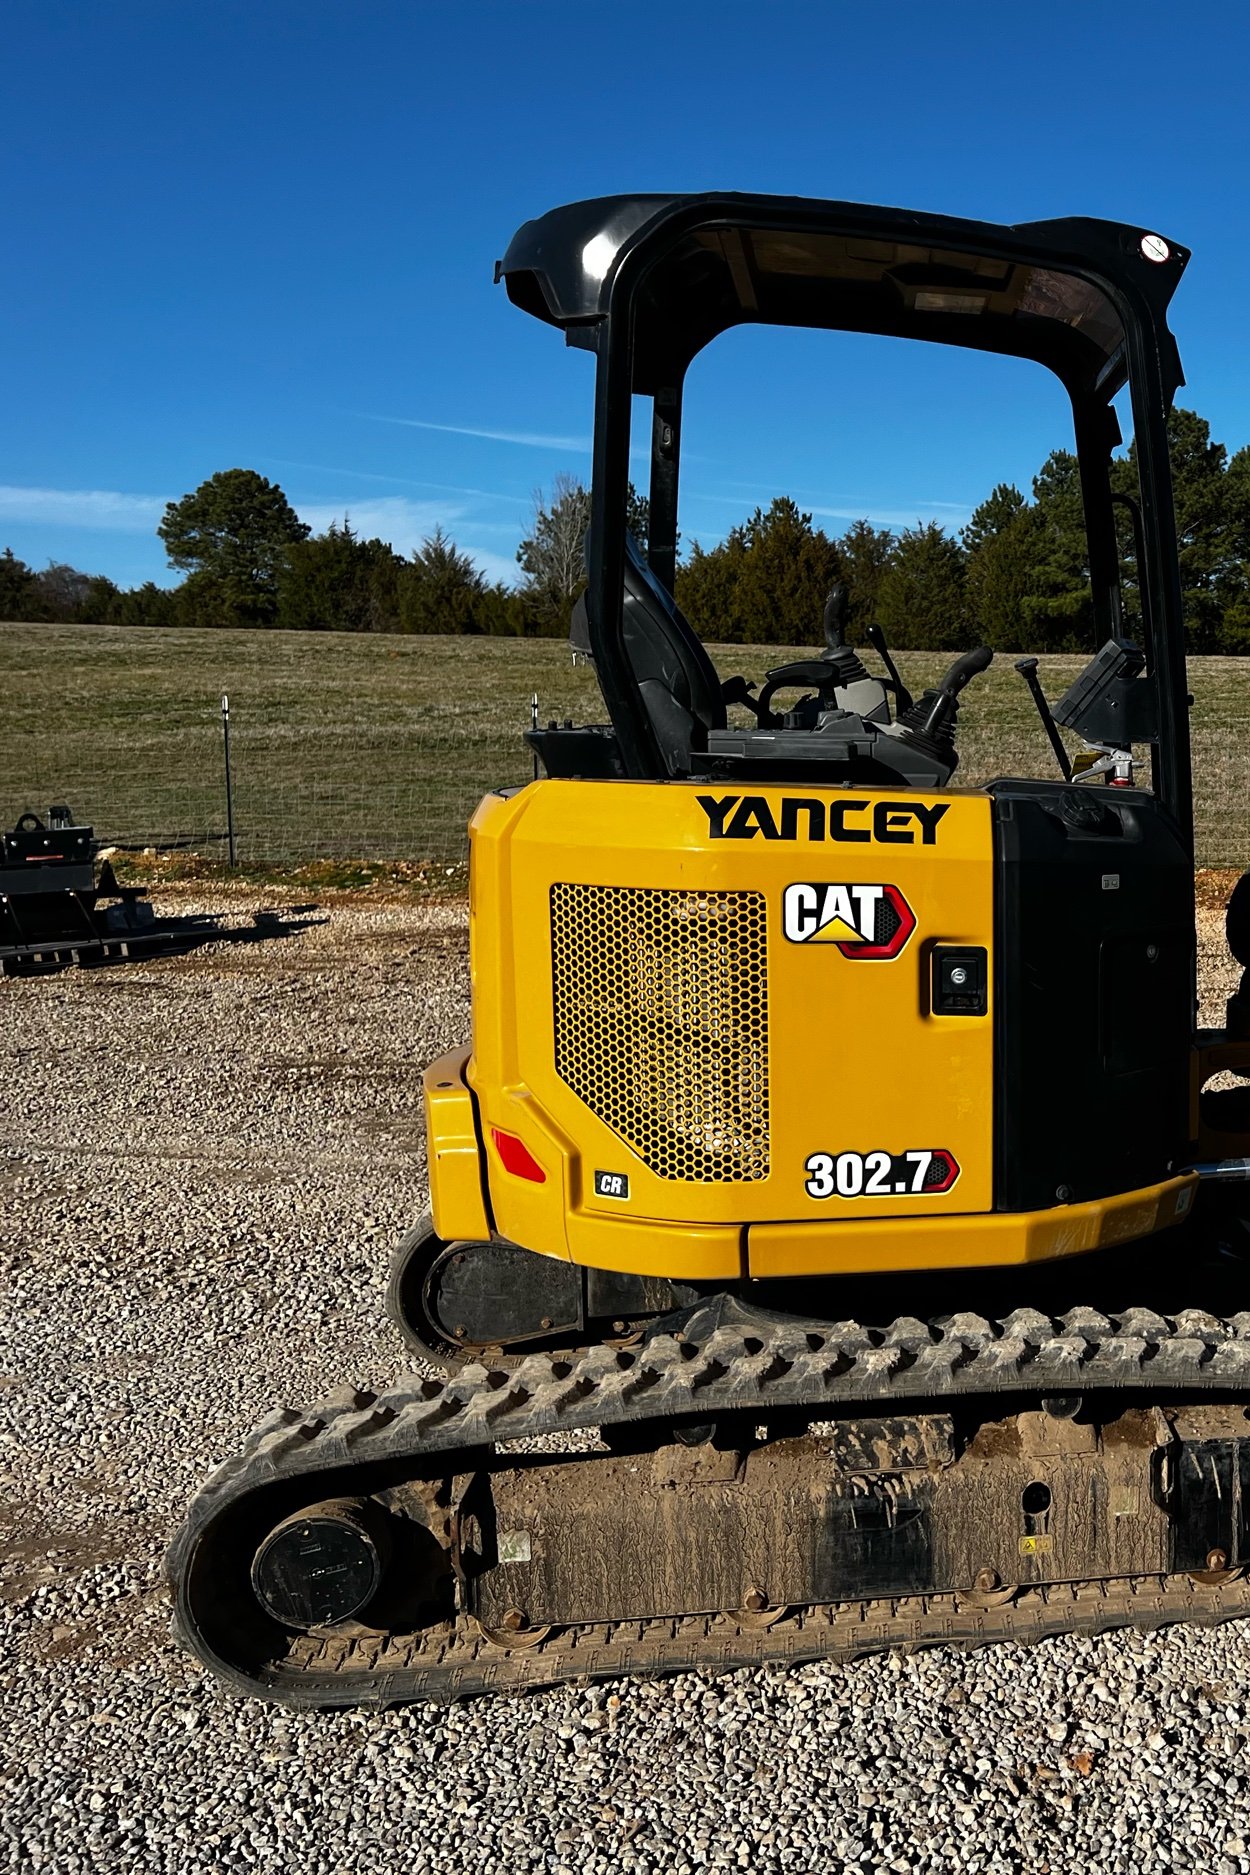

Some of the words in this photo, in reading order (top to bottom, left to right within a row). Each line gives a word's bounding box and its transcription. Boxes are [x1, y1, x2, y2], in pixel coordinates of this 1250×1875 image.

[695, 795, 952, 845] YANCEY
[784, 884, 884, 942] CAT
[600, 1175, 622, 1194] CR
[806, 1151, 932, 1197] 302.7
